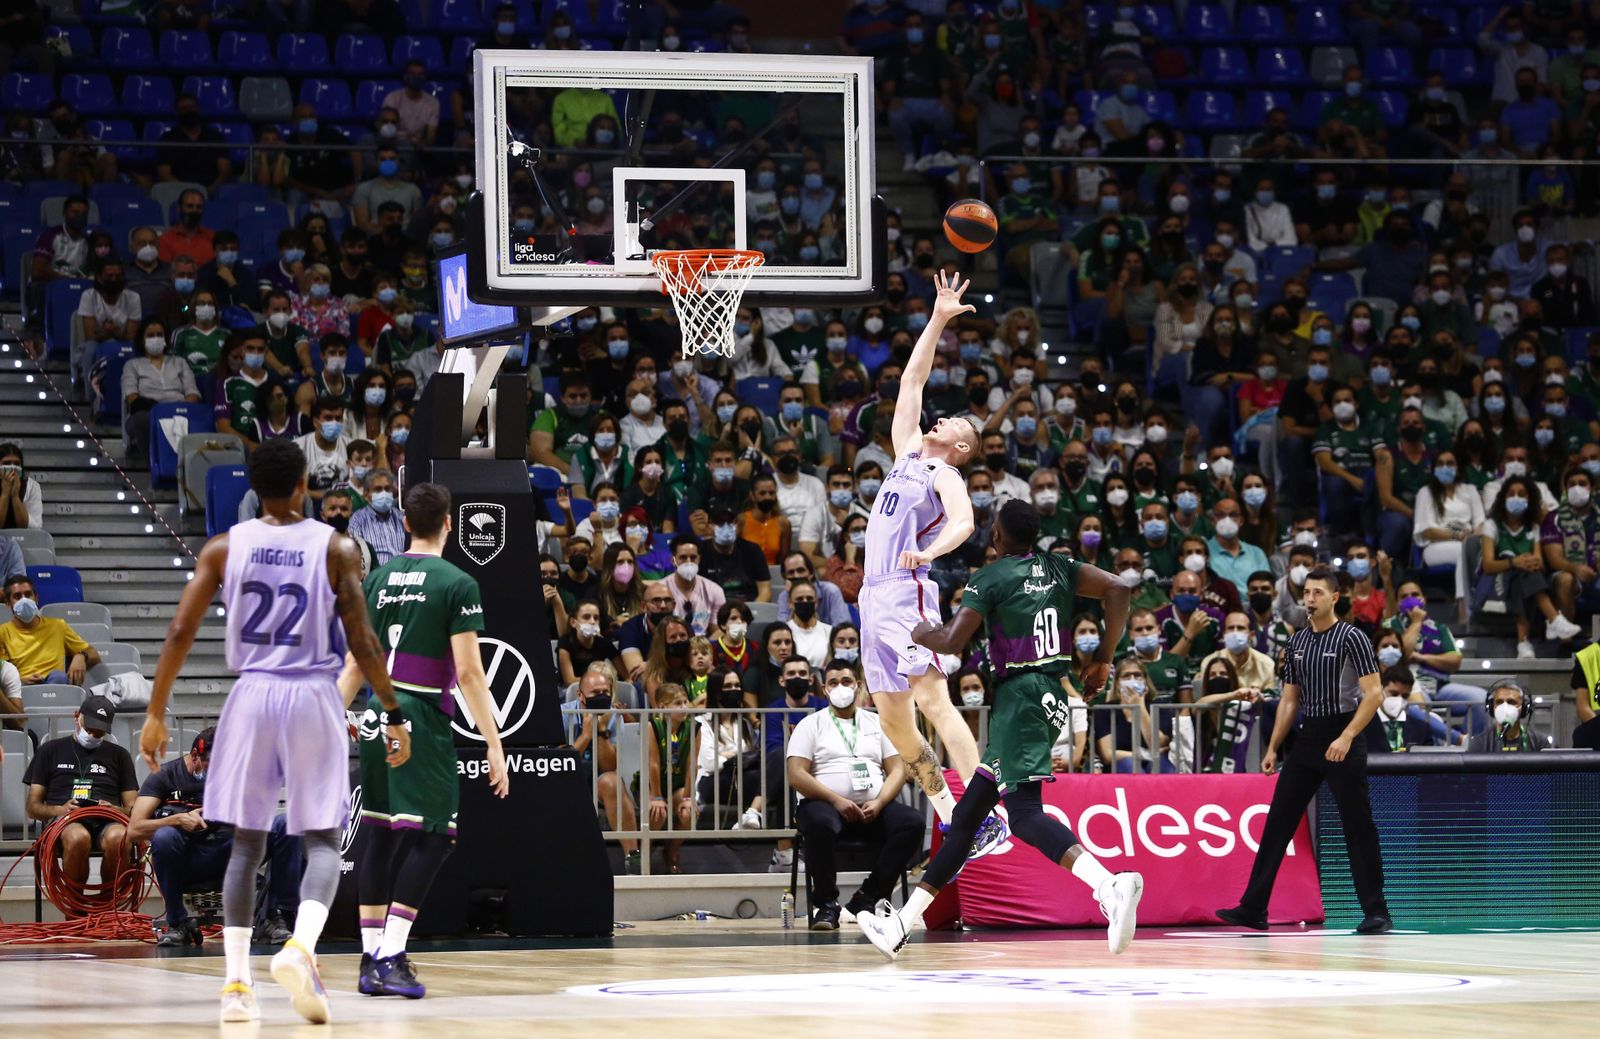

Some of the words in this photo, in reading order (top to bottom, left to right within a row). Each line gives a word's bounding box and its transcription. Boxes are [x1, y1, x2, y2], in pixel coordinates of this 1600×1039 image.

[514, 242, 533, 254] liga
[515, 252, 555, 261] endesa
[880, 491, 900, 517] 10
[469, 532, 495, 542] Unicaja
[250, 547, 304, 568] HIGGINS
[240, 580, 310, 647] 22
